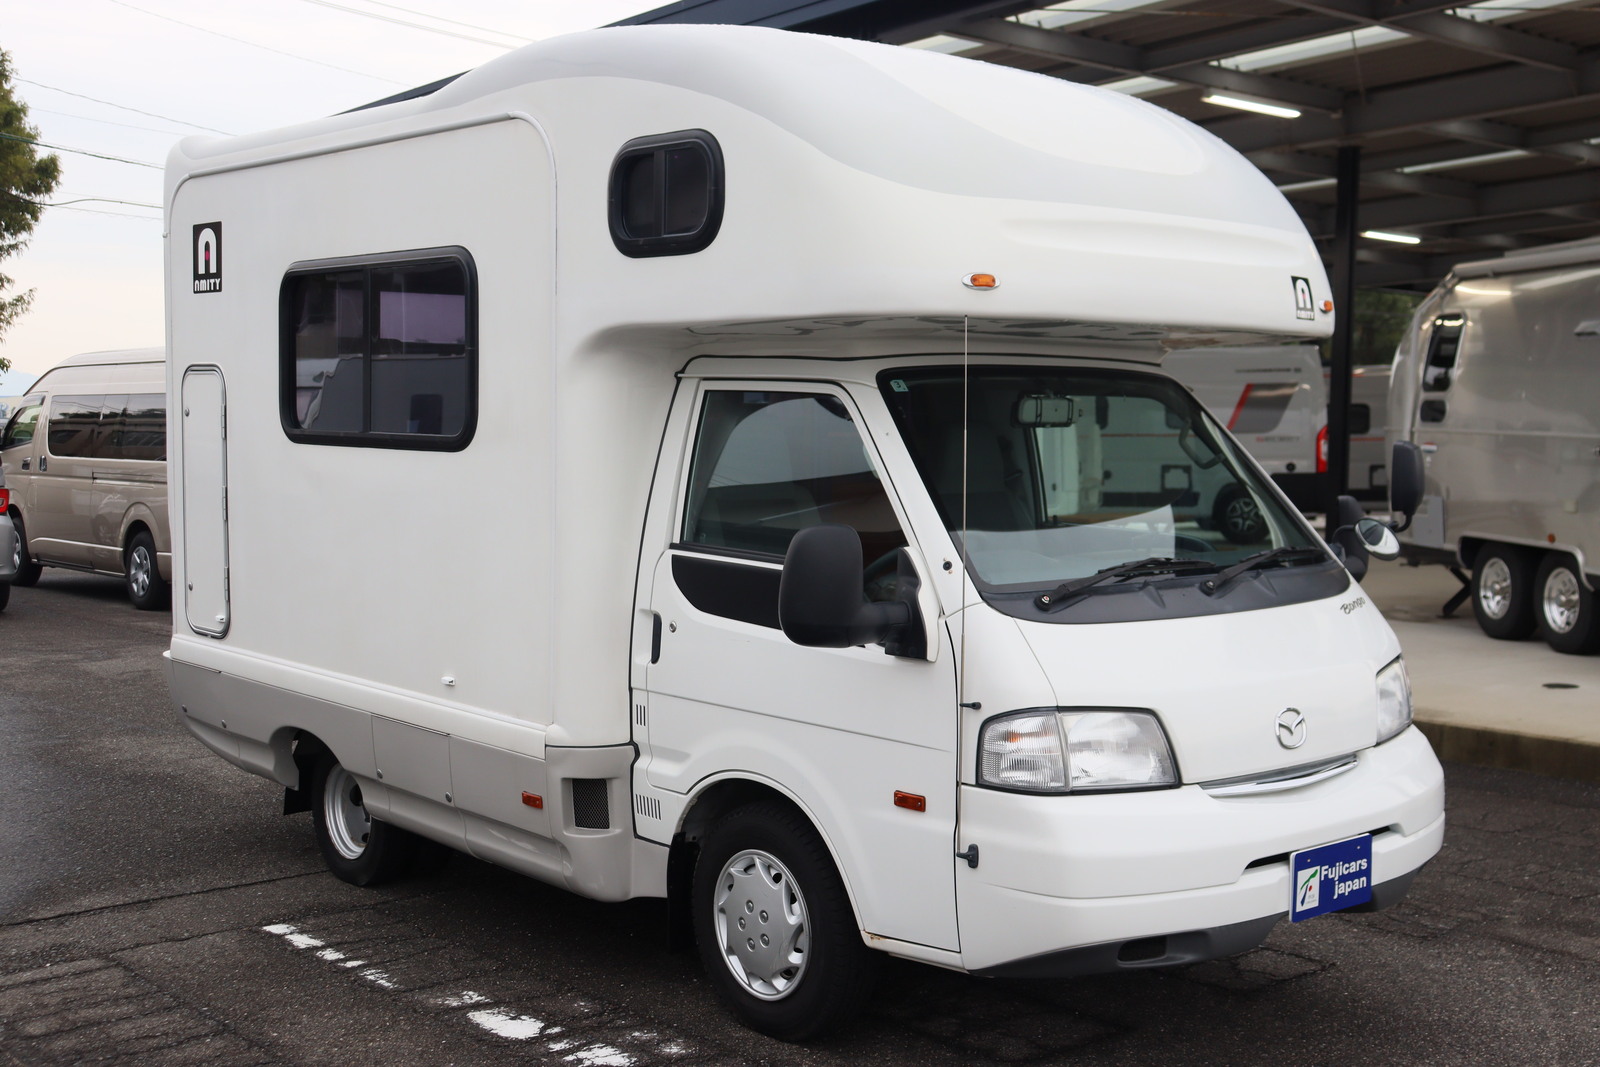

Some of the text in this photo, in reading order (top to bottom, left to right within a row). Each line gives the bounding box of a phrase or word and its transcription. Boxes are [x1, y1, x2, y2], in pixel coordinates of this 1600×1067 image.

[194, 278, 221, 292] AMITY
[1340, 597, 1366, 615] Bongo
[1321, 858, 1368, 881] Fujicars
[1333, 876, 1367, 899] japan
